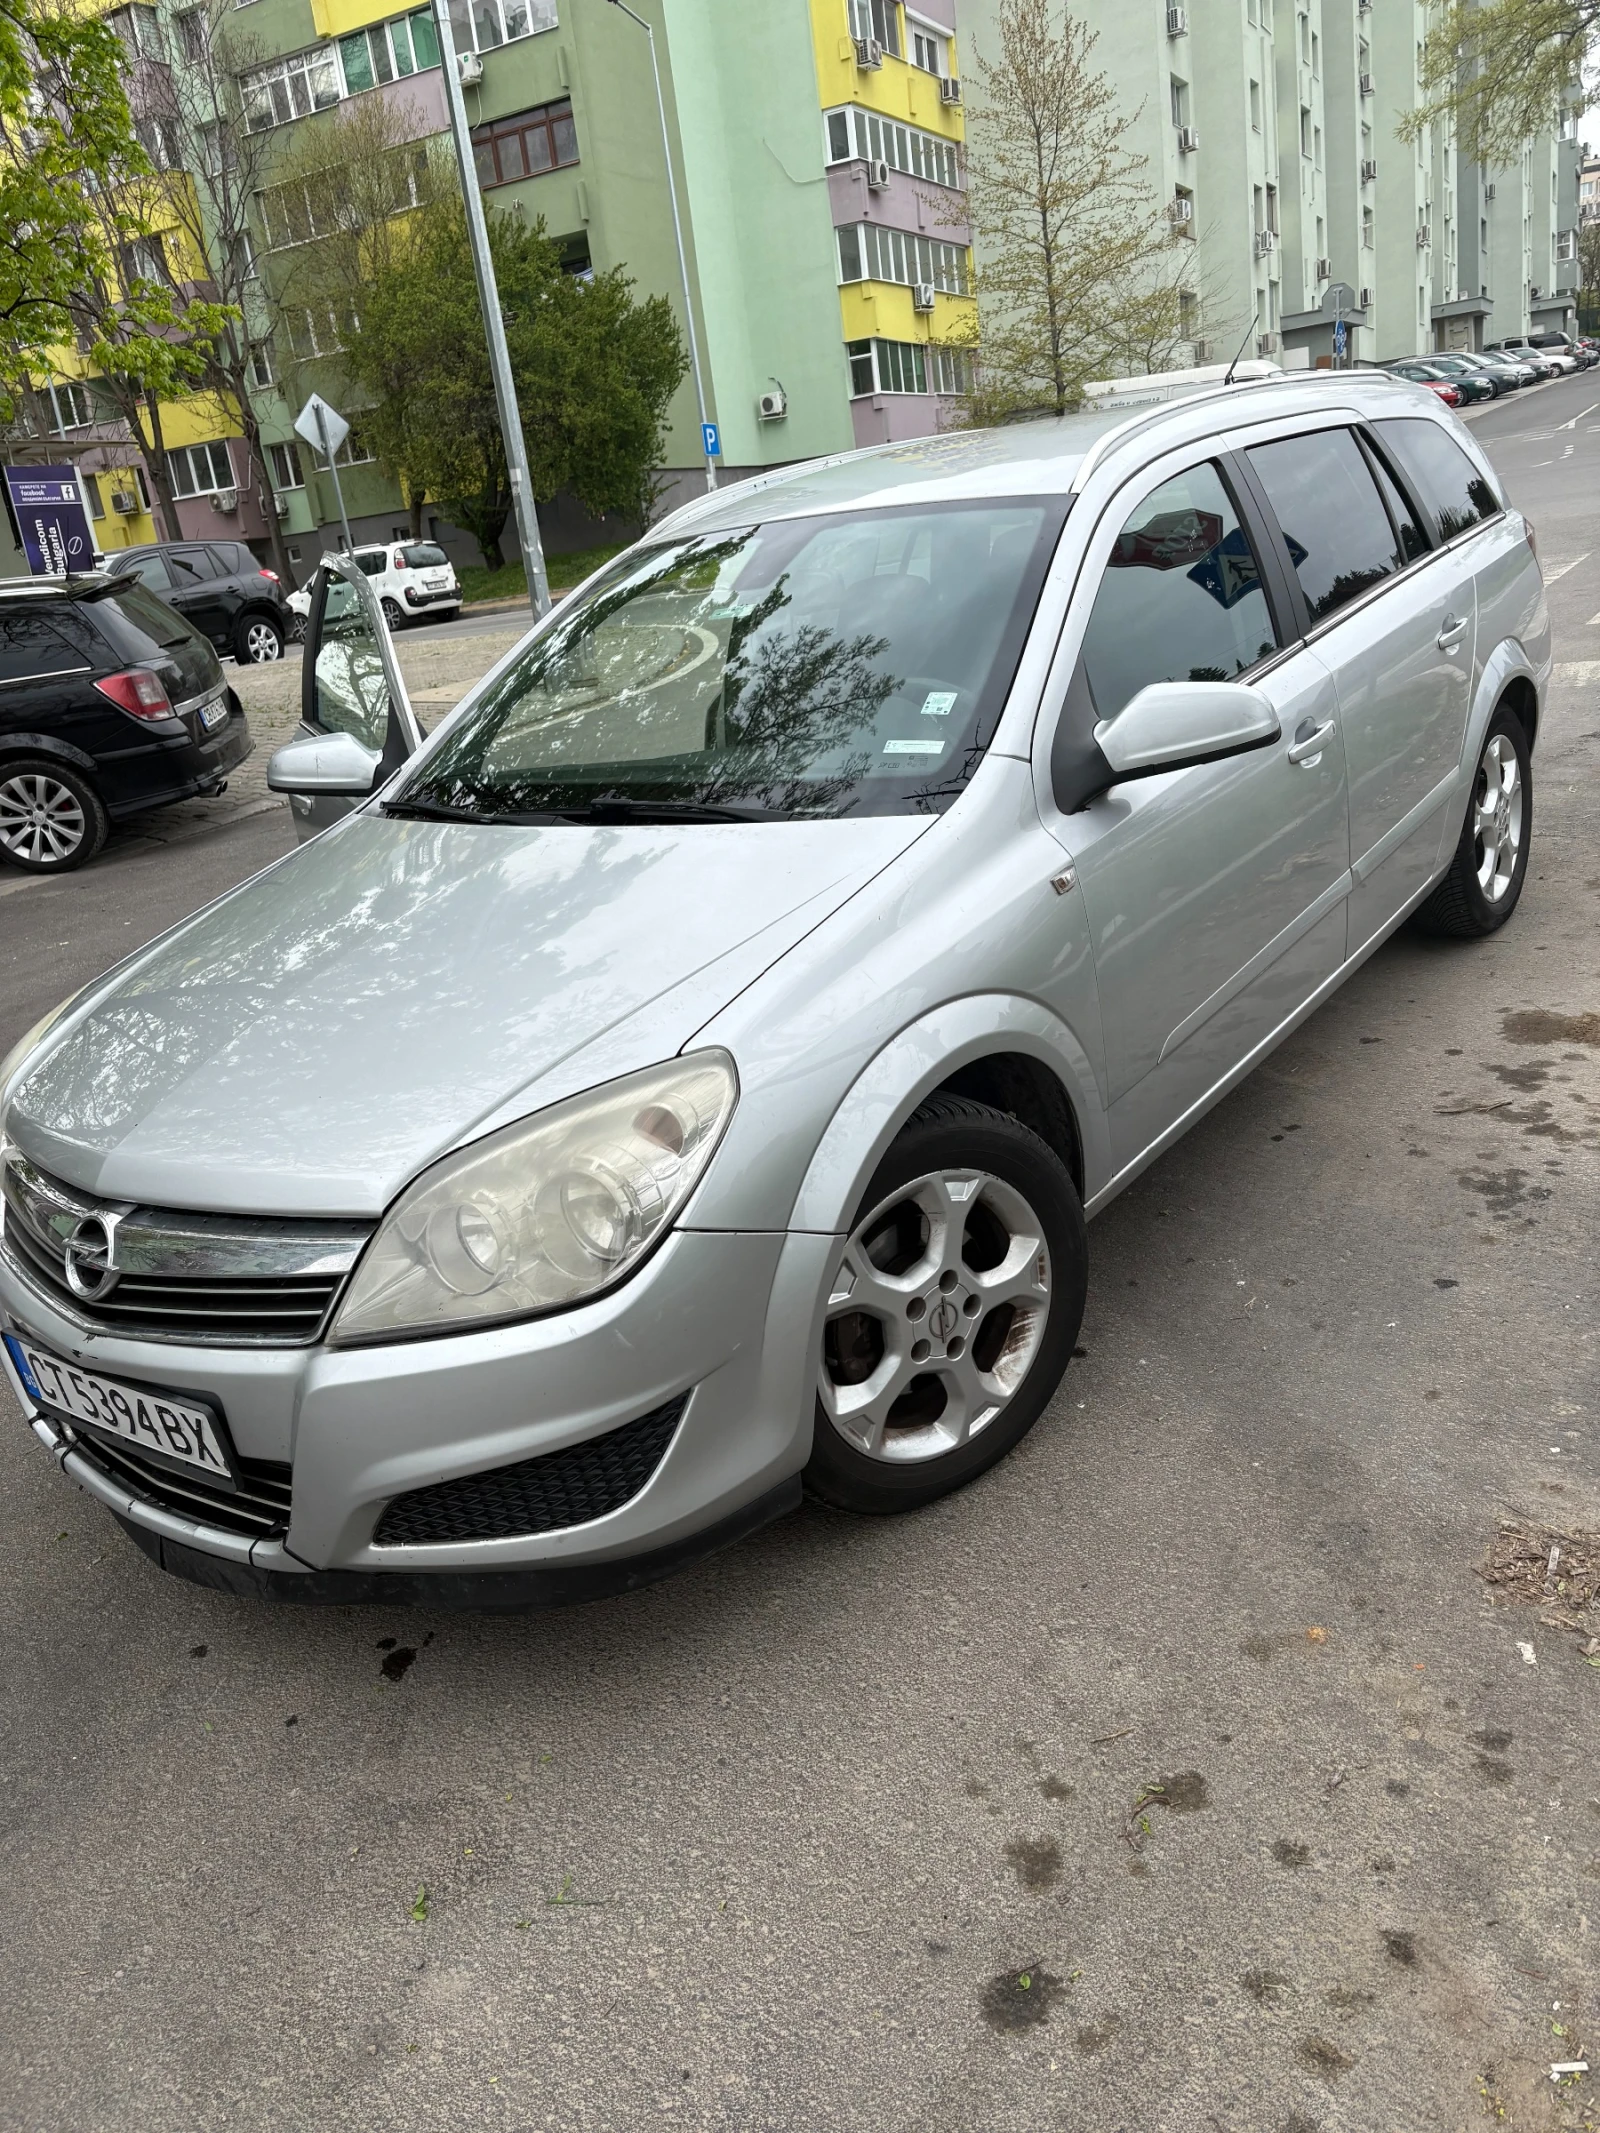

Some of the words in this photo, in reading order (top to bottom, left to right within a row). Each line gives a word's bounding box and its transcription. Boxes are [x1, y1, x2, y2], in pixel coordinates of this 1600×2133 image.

[705, 427, 716, 452] P
[20, 489, 45, 497] facebook
[48, 526, 67, 575] Bulgaria
[23, 1372, 38, 1389] BG
